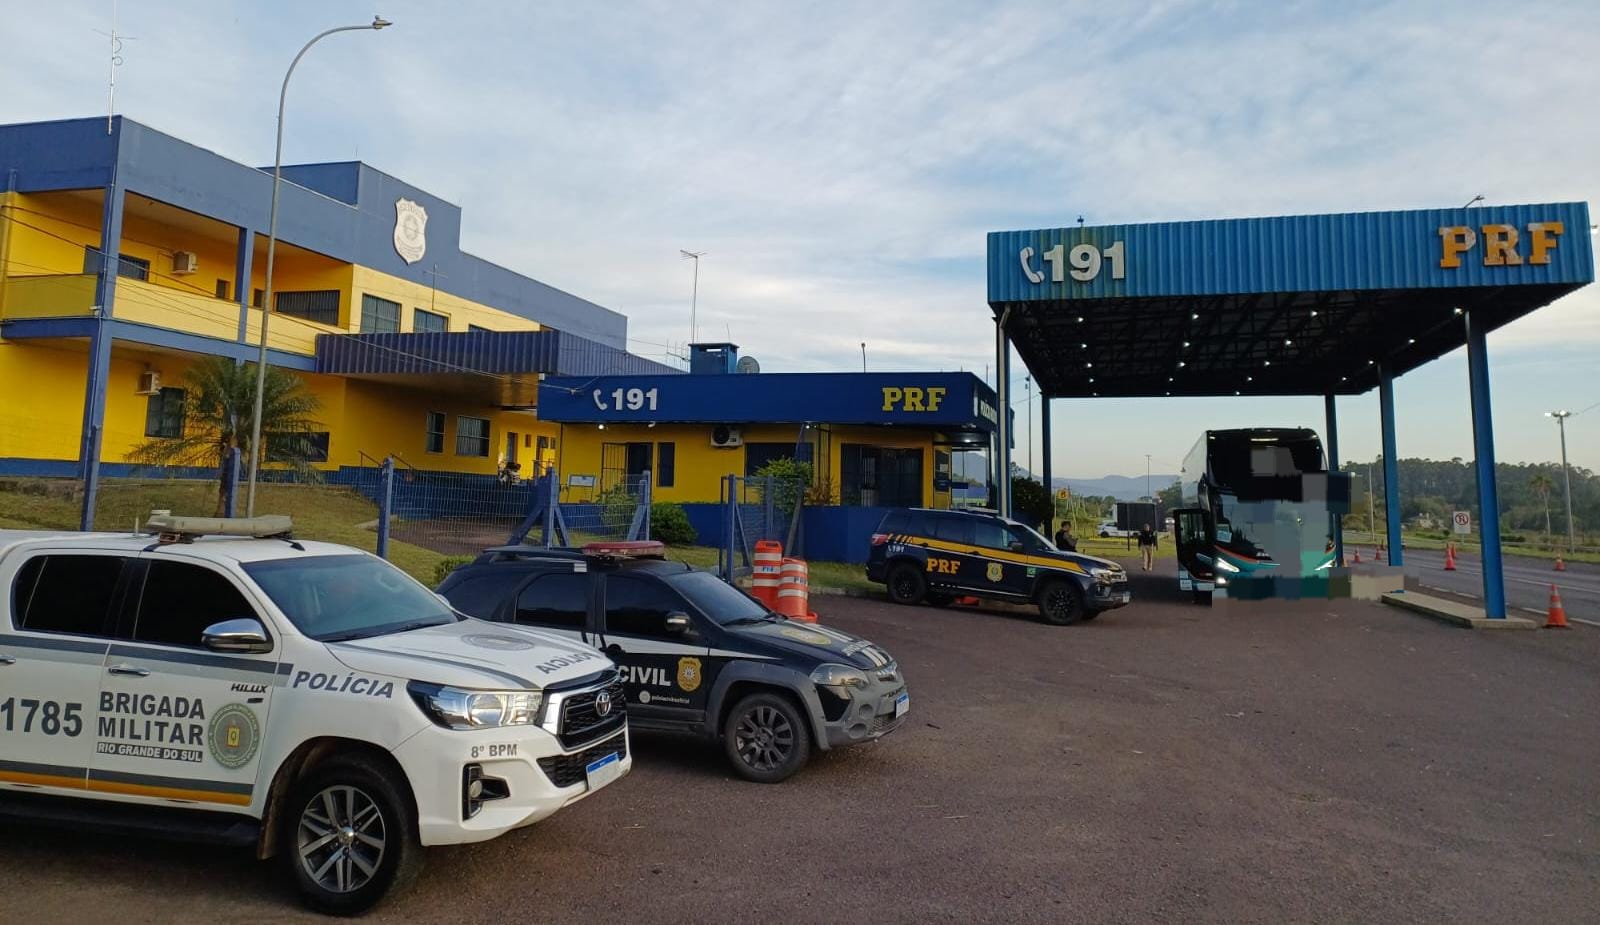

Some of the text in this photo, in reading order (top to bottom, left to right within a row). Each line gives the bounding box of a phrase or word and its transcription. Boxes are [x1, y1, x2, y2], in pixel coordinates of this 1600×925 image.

[1439, 221, 1564, 268] PRF
[1043, 241, 1125, 282] 191
[612, 388, 658, 411] 191
[882, 387, 946, 412] PRF
[926, 558, 961, 575] PRF
[231, 683, 269, 694] HILUX
[293, 671, 394, 699] POLÍCIA
[618, 665, 672, 687] CIVIL
[0, 697, 83, 737] 1785
[100, 691, 206, 720] BRIGADA
[98, 716, 204, 746] MILITAR
[98, 743, 203, 762] RIO GRANDE DO SUL
[489, 743, 518, 756] BPM
